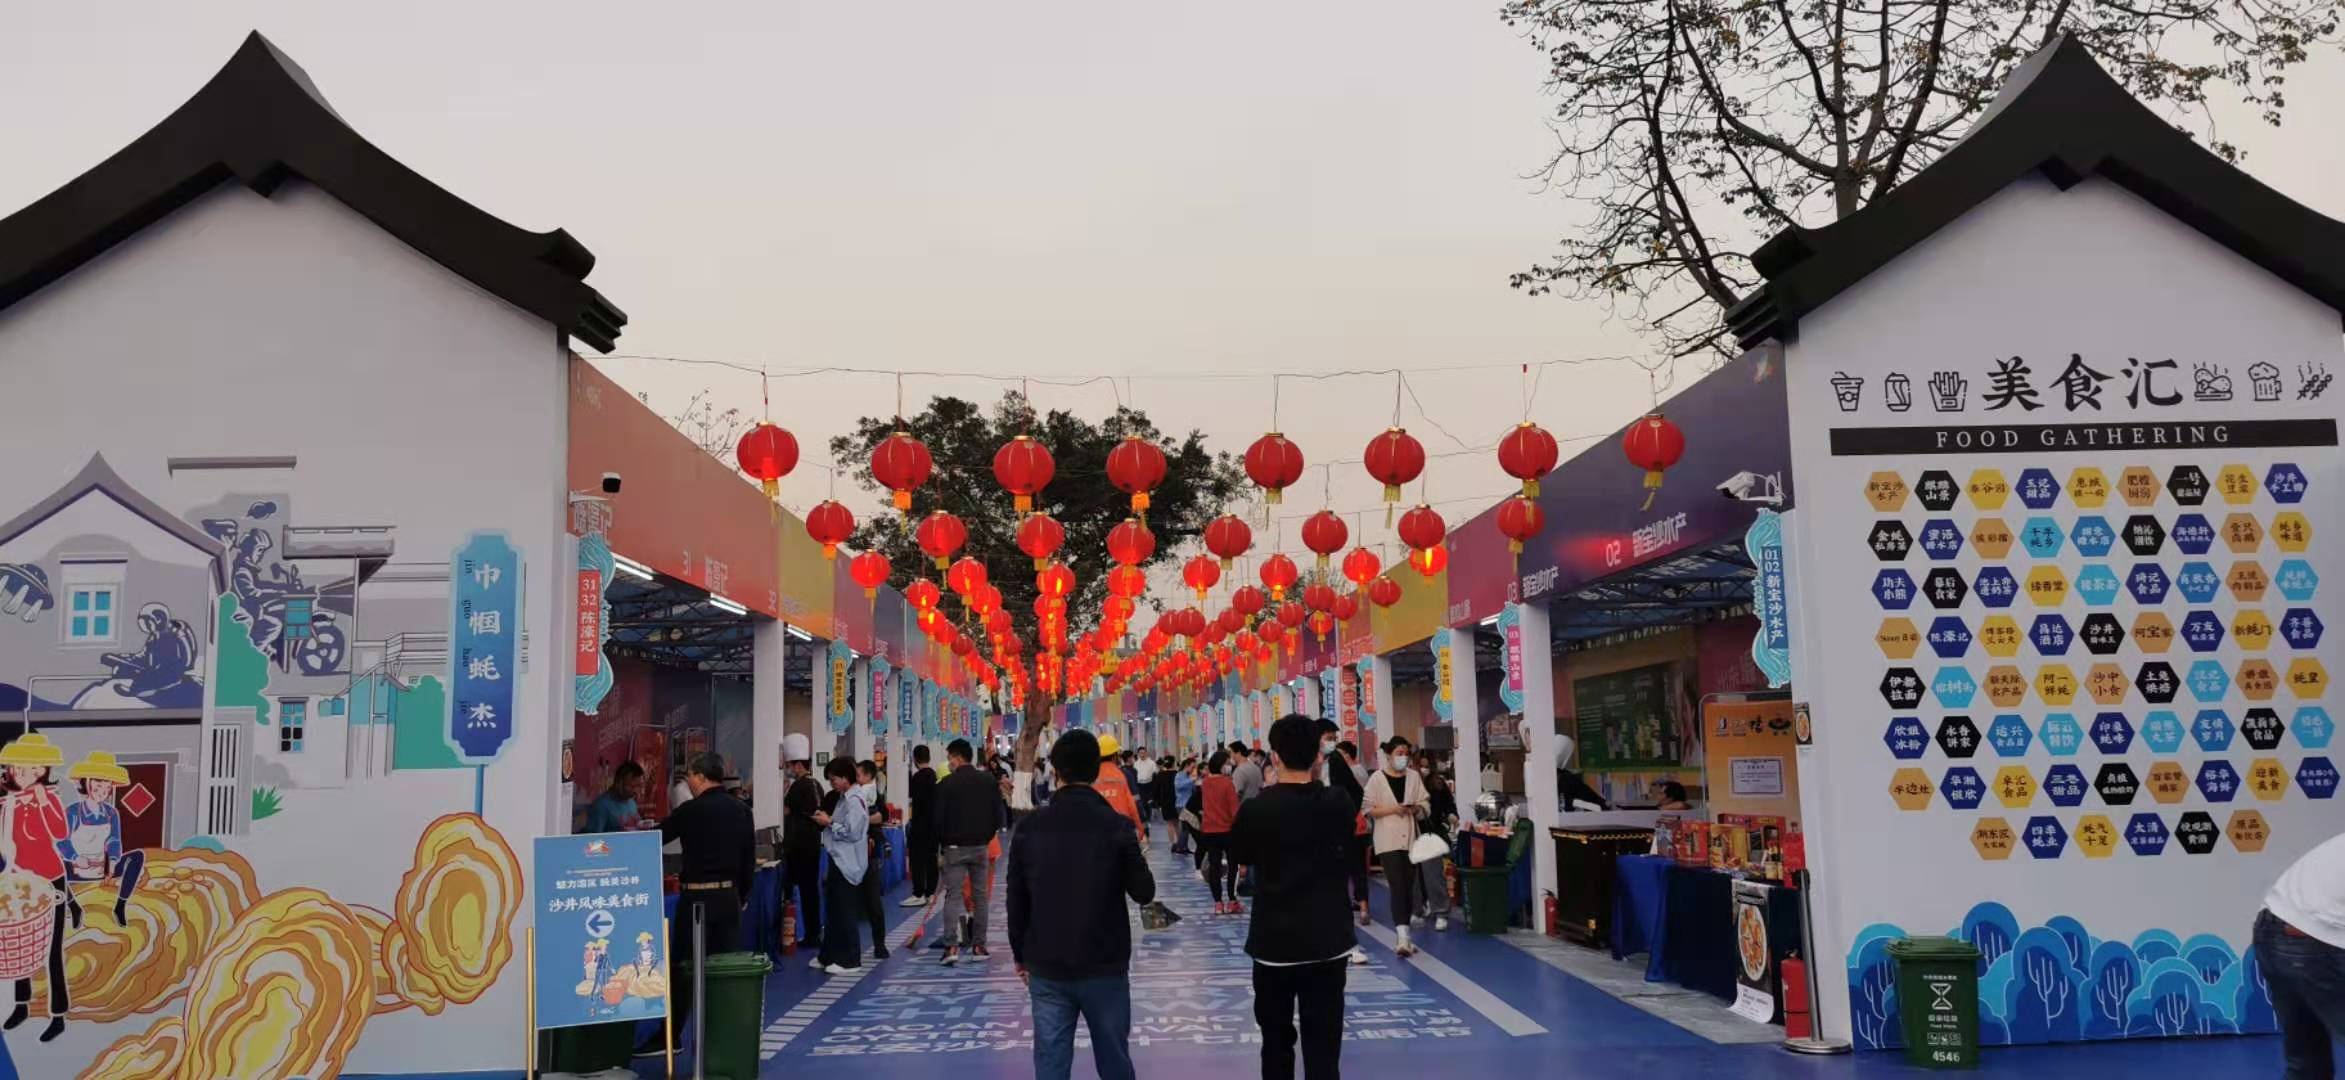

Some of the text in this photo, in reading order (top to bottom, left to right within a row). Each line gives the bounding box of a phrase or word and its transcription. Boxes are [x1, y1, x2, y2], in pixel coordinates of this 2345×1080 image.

[1983, 353, 2184, 412] 美食汇
[1936, 424, 2230, 448] FOOD GATHERING
[2176, 472, 2200, 485] 一号
[2275, 472, 2297, 482] 沙井
[1632, 512, 1687, 557] 新宝沙水产
[1605, 540, 1621, 567] 02
[1764, 549, 1779, 560] 01
[1765, 561, 1780, 572] 02
[582, 579, 596, 591] 31
[1883, 577, 1906, 588] 功夫
[2137, 583, 2161, 594] 食品
[1507, 581, 1518, 601] 03
[1884, 589, 1906, 600] 小熊
[580, 594, 598, 606] 32
[1767, 574, 1784, 643] 新宝沙水产
[2089, 624, 2114, 634] 沙井
[467, 563, 501, 730] 巾帼蚝杰
[2039, 635, 2064, 646] 酒店
[2043, 674, 2068, 683] 阿一
[1890, 689, 1917, 700] 拉面
[2095, 684, 2120, 696] 小食
[2003, 785, 2028, 798] 食品
[549, 892, 649, 912] 沙井风味美食街
[831, 1020, 1020, 1034] BAO'AN
[821, 1030, 1008, 1043] OYSTER
[1933, 1050, 1960, 1063] 4546
